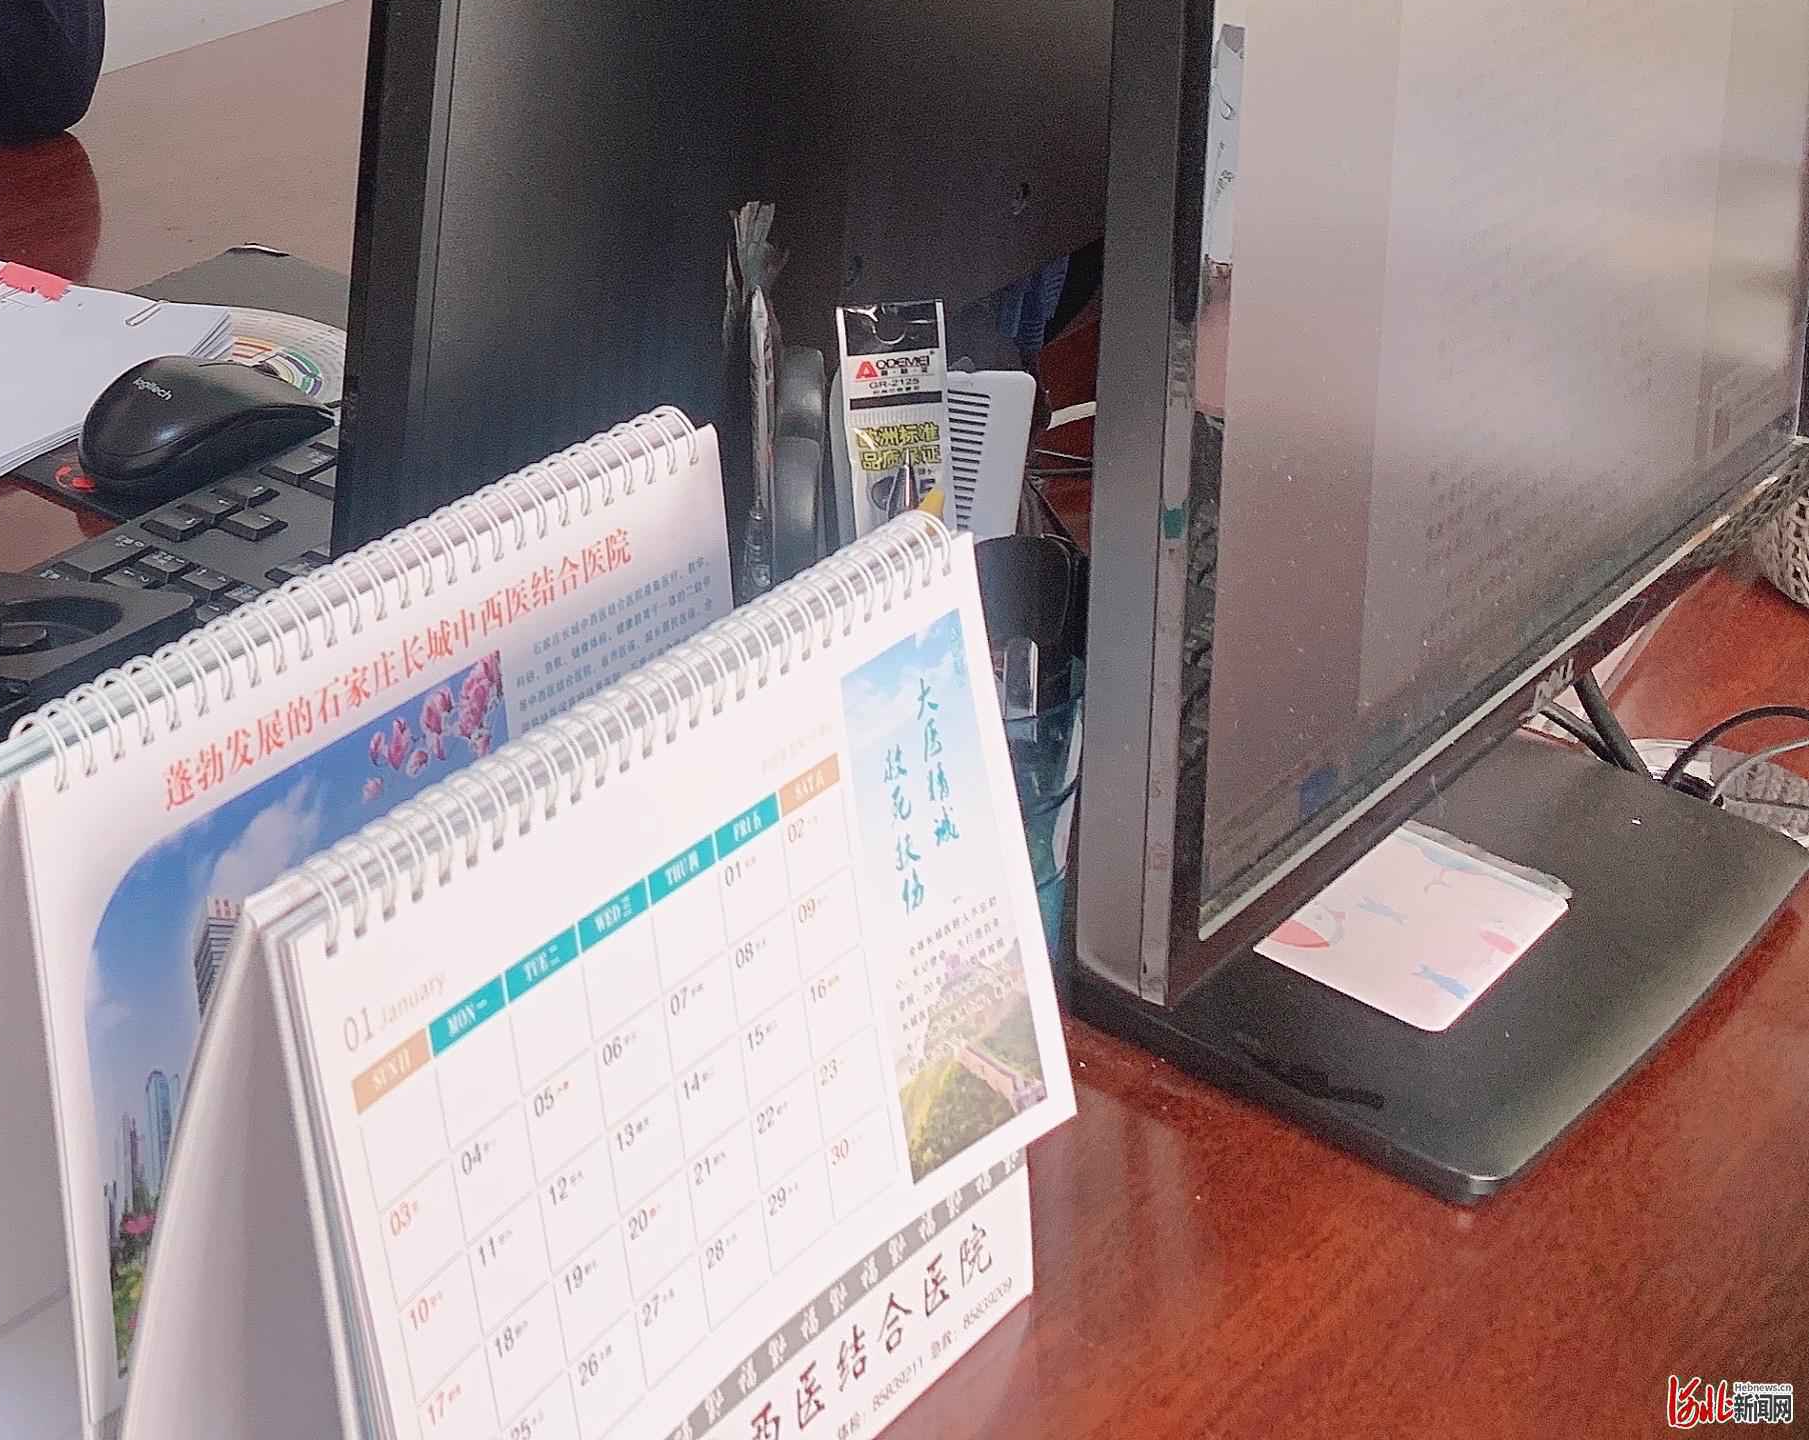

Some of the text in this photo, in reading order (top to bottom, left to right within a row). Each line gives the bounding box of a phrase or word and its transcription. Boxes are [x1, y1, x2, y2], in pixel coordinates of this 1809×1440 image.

[132, 376, 173, 401] logitech
[724, 861, 741, 887] 01
[787, 818, 805, 843] 02
[344, 1006, 373, 1051] 01
[389, 1202, 412, 1236] 03
[461, 1143, 481, 1175] 04
[533, 1086, 554, 1117] 05
[602, 1035, 622, 1066] 06
[670, 987, 687, 1016] 07
[735, 942, 753, 969] 08
[798, 898, 816, 923] 09
[409, 1297, 430, 1331] 10
[478, 1236, 496, 1267] 11
[549, 1175, 568, 1206] 12
[616, 1122, 634, 1152] 13
[683, 1071, 700, 1100] 14
[748, 1024, 764, 1051] 15
[809, 979, 826, 1003] 16
[428, 1390, 444, 1425] 17
[495, 1325, 514, 1359] 18
[564, 1264, 583, 1295] 19
[628, 1208, 648, 1241] 20
[694, 1156, 711, 1187] 21
[756, 1105, 774, 1135] 22
[819, 1059, 838, 1086] 23
[578, 1353, 598, 1387] 26
[641, 1293, 659, 1327] 27
[705, 1238, 724, 1269] 28
[768, 1186, 786, 1216] 29
[831, 1138, 849, 1166] 30
